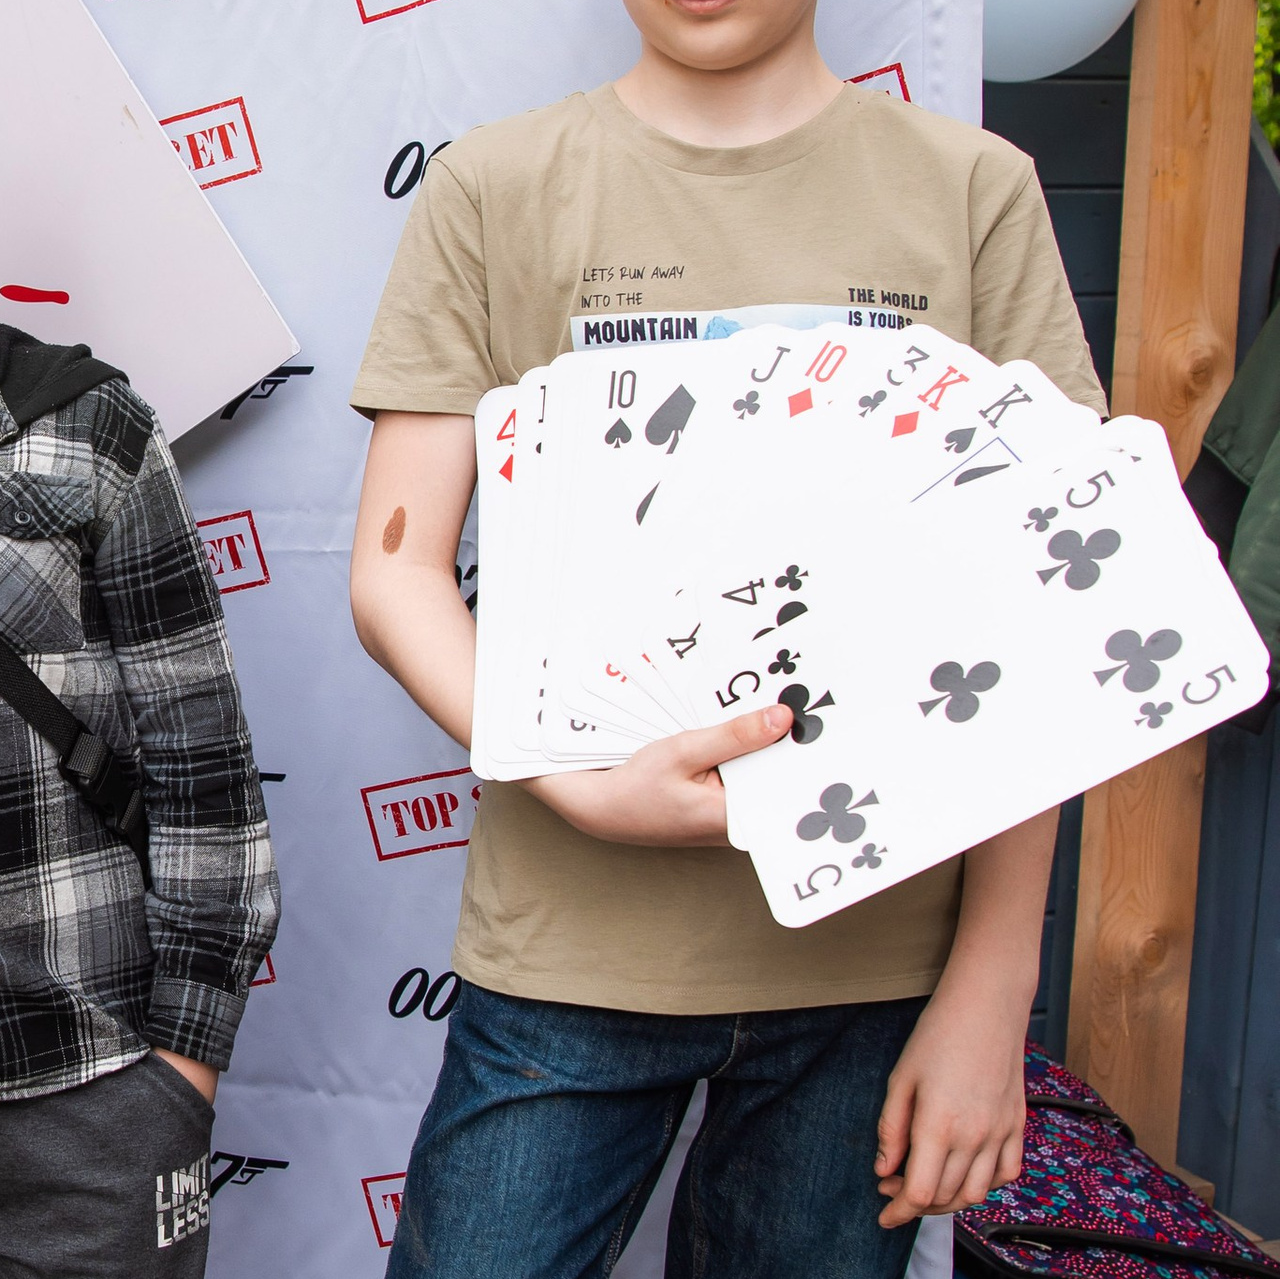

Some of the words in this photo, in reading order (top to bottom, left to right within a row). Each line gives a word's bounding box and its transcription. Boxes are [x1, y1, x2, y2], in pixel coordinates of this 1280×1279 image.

[582, 266, 615, 283] LETS
[619, 266, 646, 281] RUN
[650, 265, 685, 280] AWAY
[581, 294, 611, 309] INTO
[615, 292, 643, 307] THE
[847, 287, 876, 304] THE
[880, 289, 929, 312] WORLD
[848, 310, 863, 327] IS
[584, 317, 698, 345] MOUNTAIN
[750, 346, 791, 383] J
[805, 340, 847, 383] 10
[608, 370, 637, 410] 10
[917, 365, 970, 412] K
[978, 383, 1033, 429] K
[1066, 470, 1116, 509] 5
[721, 578, 765, 605] 4
[715, 670, 761, 708] 5
[1181, 663, 1238, 705] 5
[381, 791, 459, 838] TOP
[793, 863, 843, 901] 5
[388, 967, 463, 1022] 00
[155, 1152, 209, 1212] LIMIT
[157, 1189, 211, 1248] LESS
